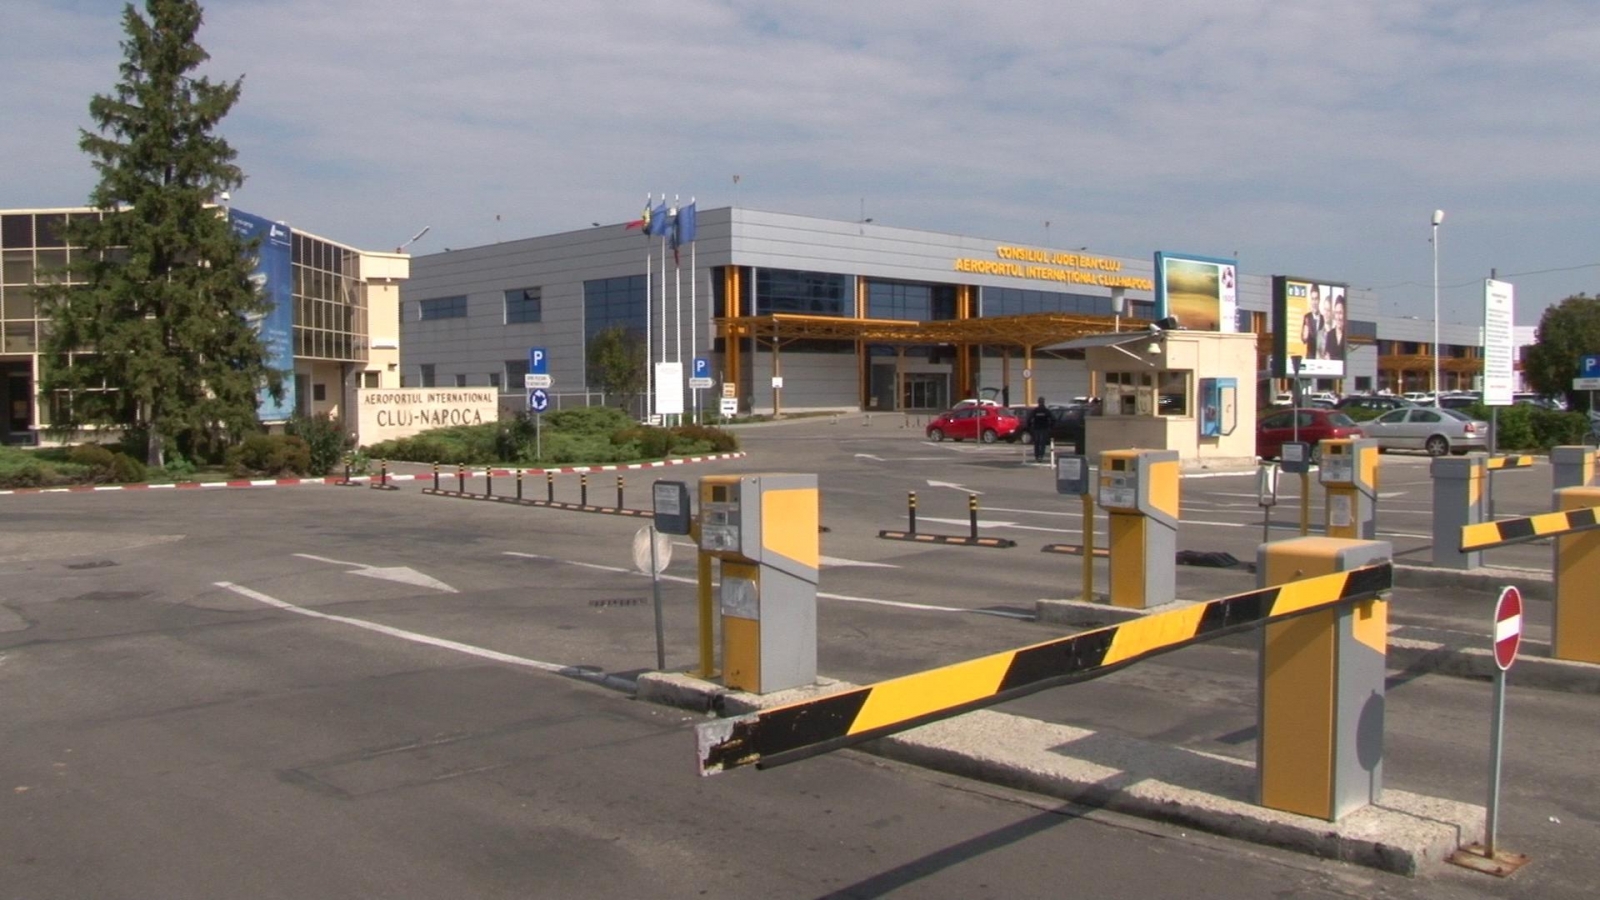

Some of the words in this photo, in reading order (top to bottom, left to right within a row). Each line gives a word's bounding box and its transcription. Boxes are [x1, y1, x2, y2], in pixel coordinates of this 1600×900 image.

[996, 246, 1048, 264] CONSILIUL
[1098, 259, 1122, 272] CLUJ
[955, 258, 1024, 278] AEROPORTUL
[534, 350, 543, 366] P
[1586, 358, 1596, 372] P
[696, 360, 706, 373] P
[364, 393, 422, 405] AEROPORTUL
[427, 392, 493, 404] INTERNATIONAL
[377, 408, 483, 427] CLUJ-NAPOCA
